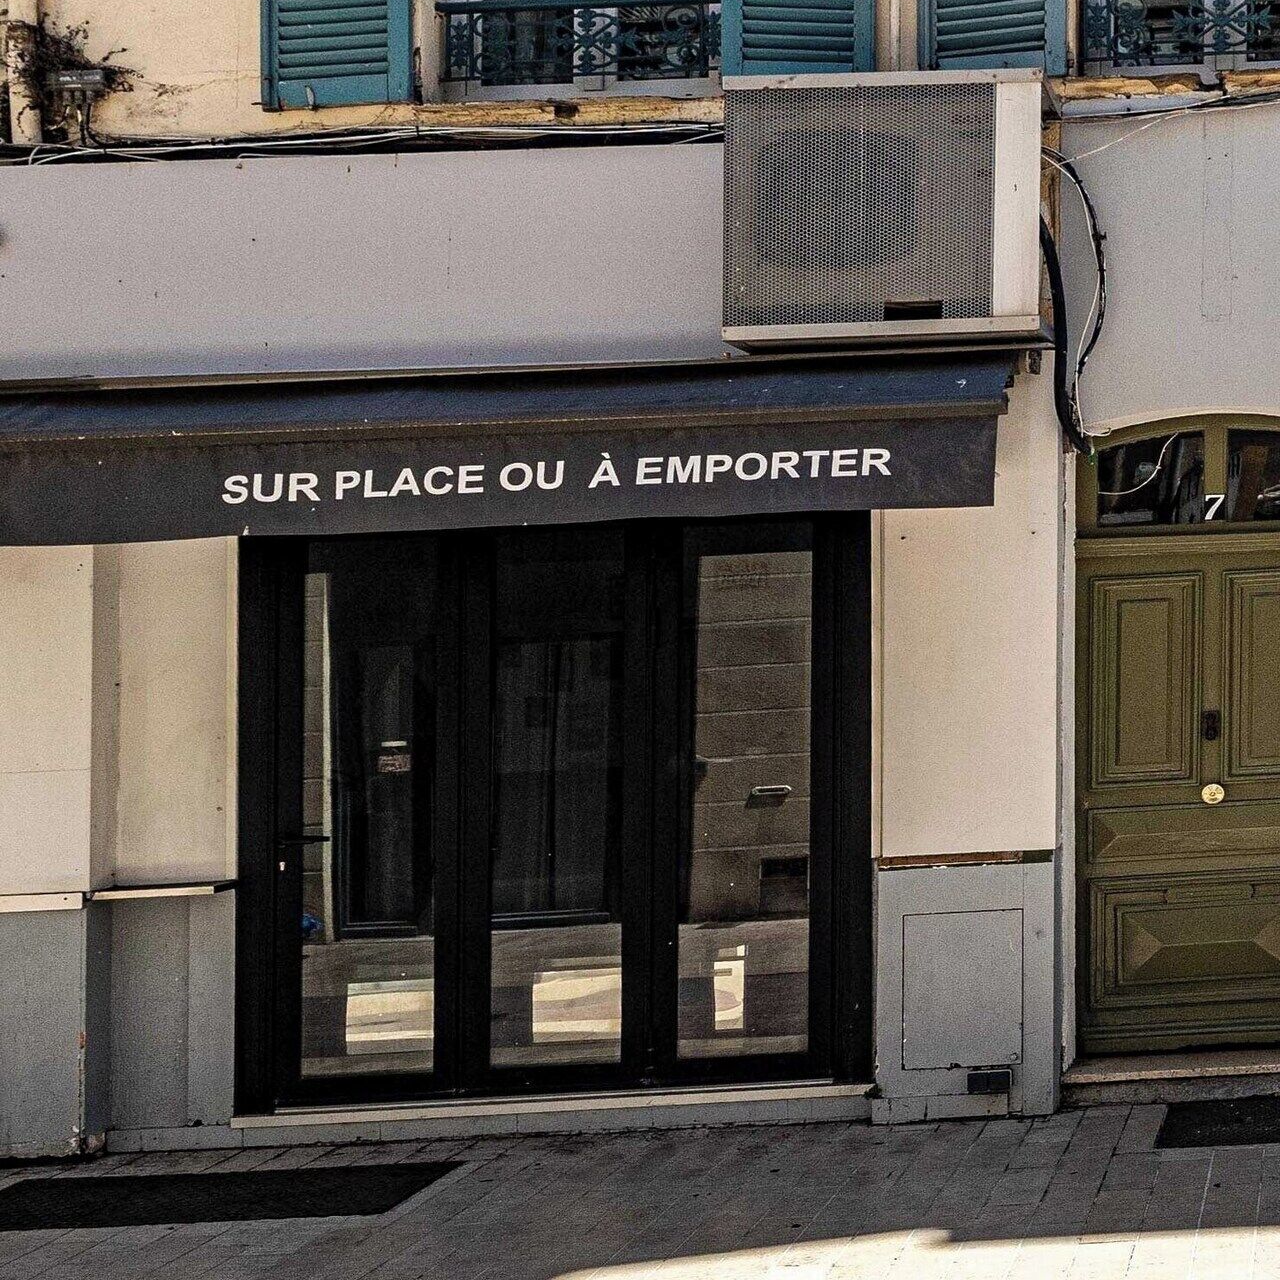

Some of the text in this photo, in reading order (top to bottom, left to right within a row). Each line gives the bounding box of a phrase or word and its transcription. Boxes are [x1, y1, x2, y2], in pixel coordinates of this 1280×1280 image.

[221, 448, 892, 505] SUR PLACE OU À EMPORTER
[1204, 494, 1225, 521] 7
